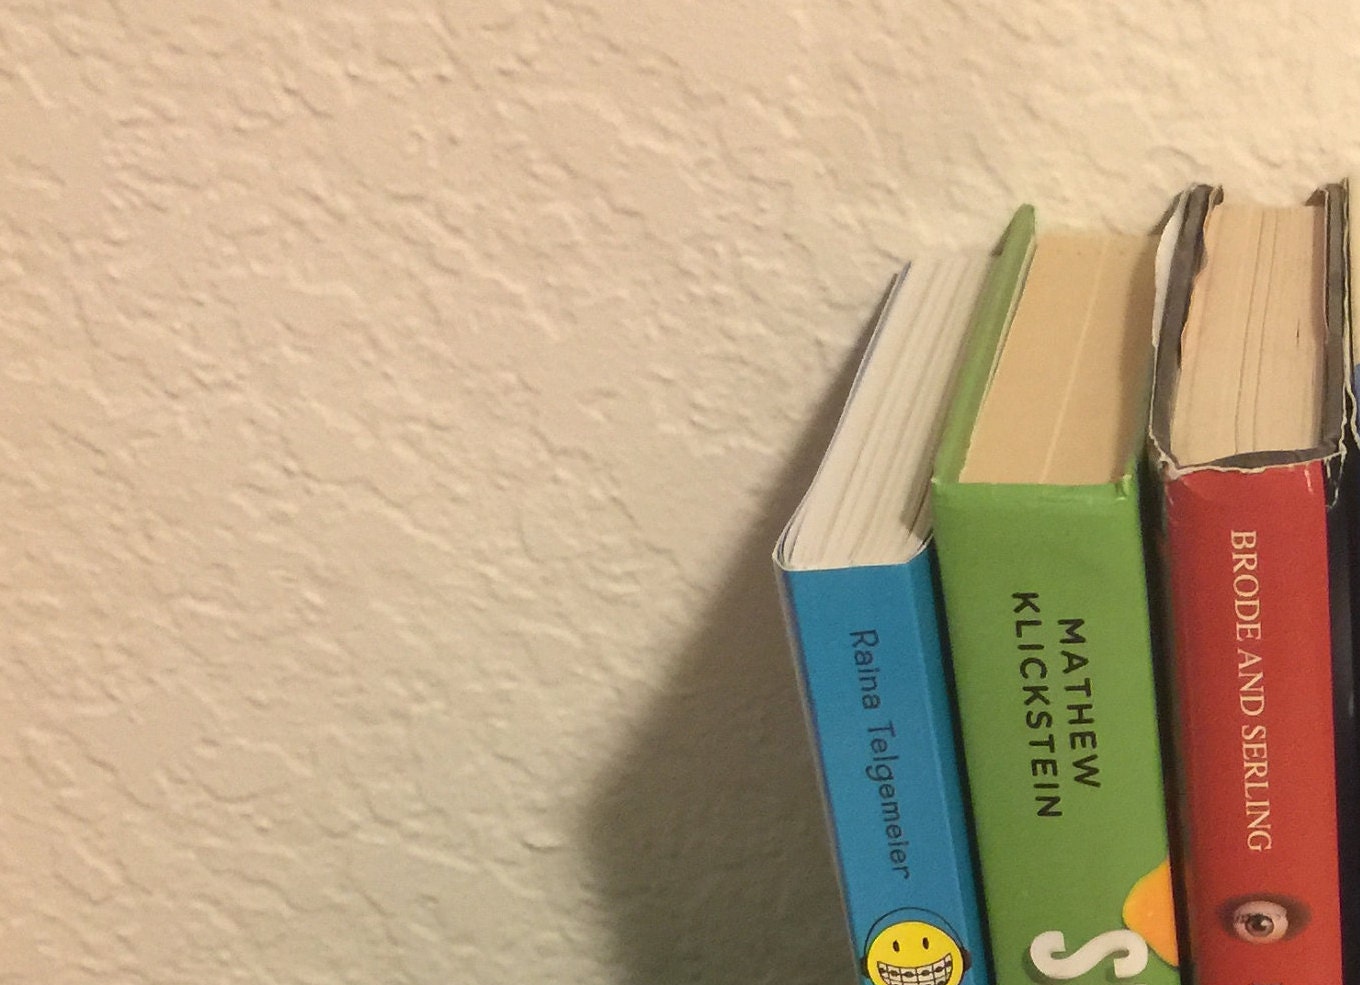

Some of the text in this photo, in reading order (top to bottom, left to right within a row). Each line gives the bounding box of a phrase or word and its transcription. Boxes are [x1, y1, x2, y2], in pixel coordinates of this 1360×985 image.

[849, 629, 910, 880] Raina Telgemeier
[1011, 592, 1063, 817] KLICKSTEIN
[1058, 618, 1101, 788] MATHEW
[1230, 529, 1272, 852] BRODE AND SERLING
